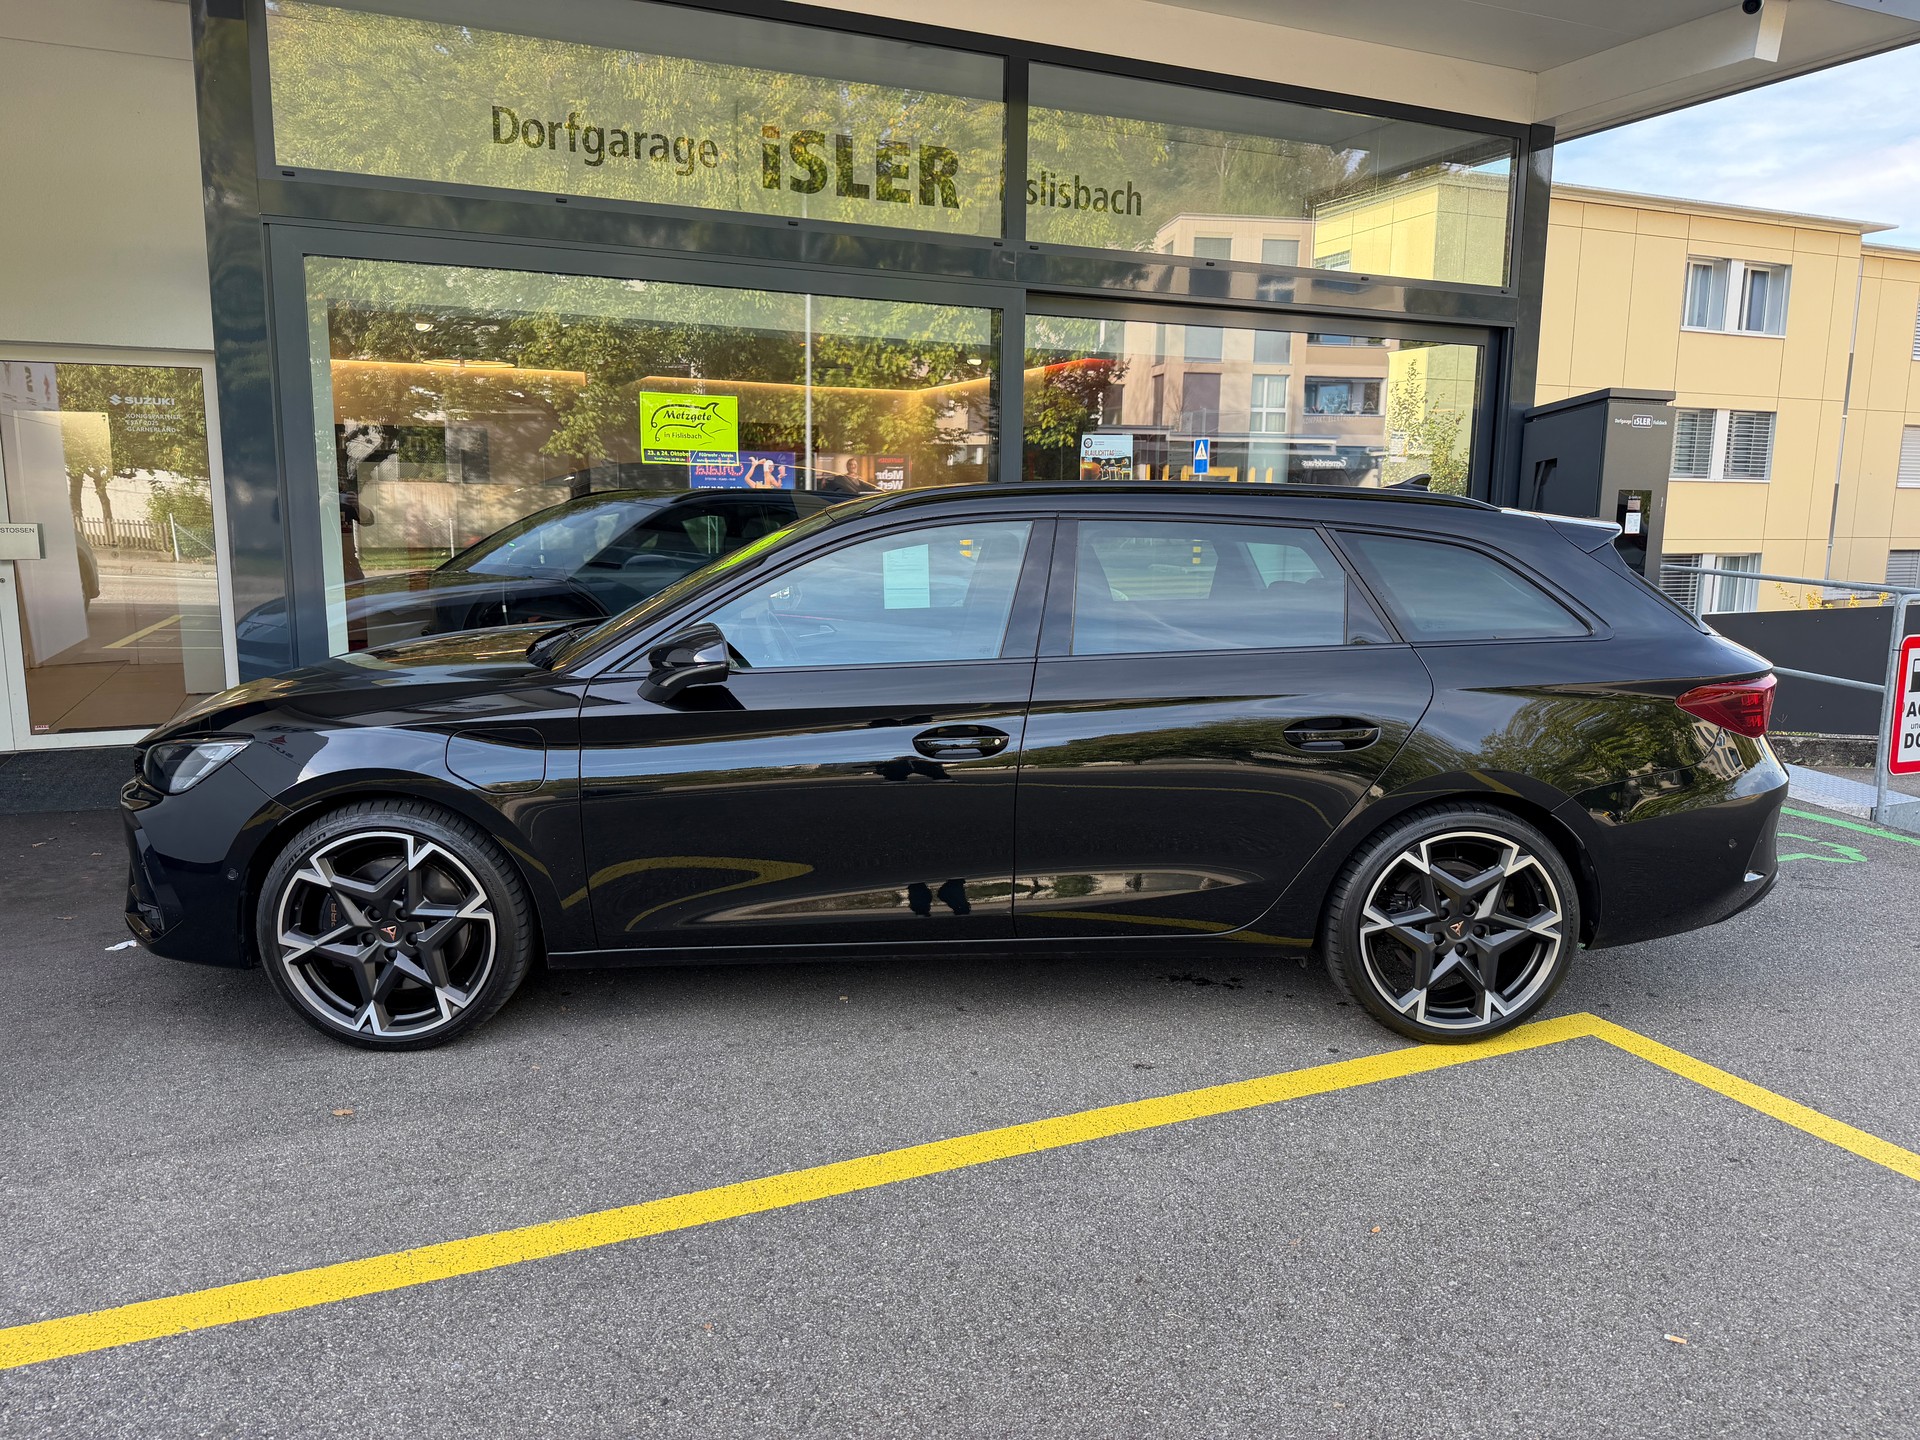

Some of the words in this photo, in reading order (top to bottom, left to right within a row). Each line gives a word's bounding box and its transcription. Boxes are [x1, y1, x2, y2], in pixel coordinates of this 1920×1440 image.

[491, 105, 719, 177] Dorfgarage
[1025, 171, 1142, 216] slisbach
[124, 396, 175, 406] SUZUKI
[663, 410, 712, 423] Metzgete
[1906, 702, 1920, 717] A
